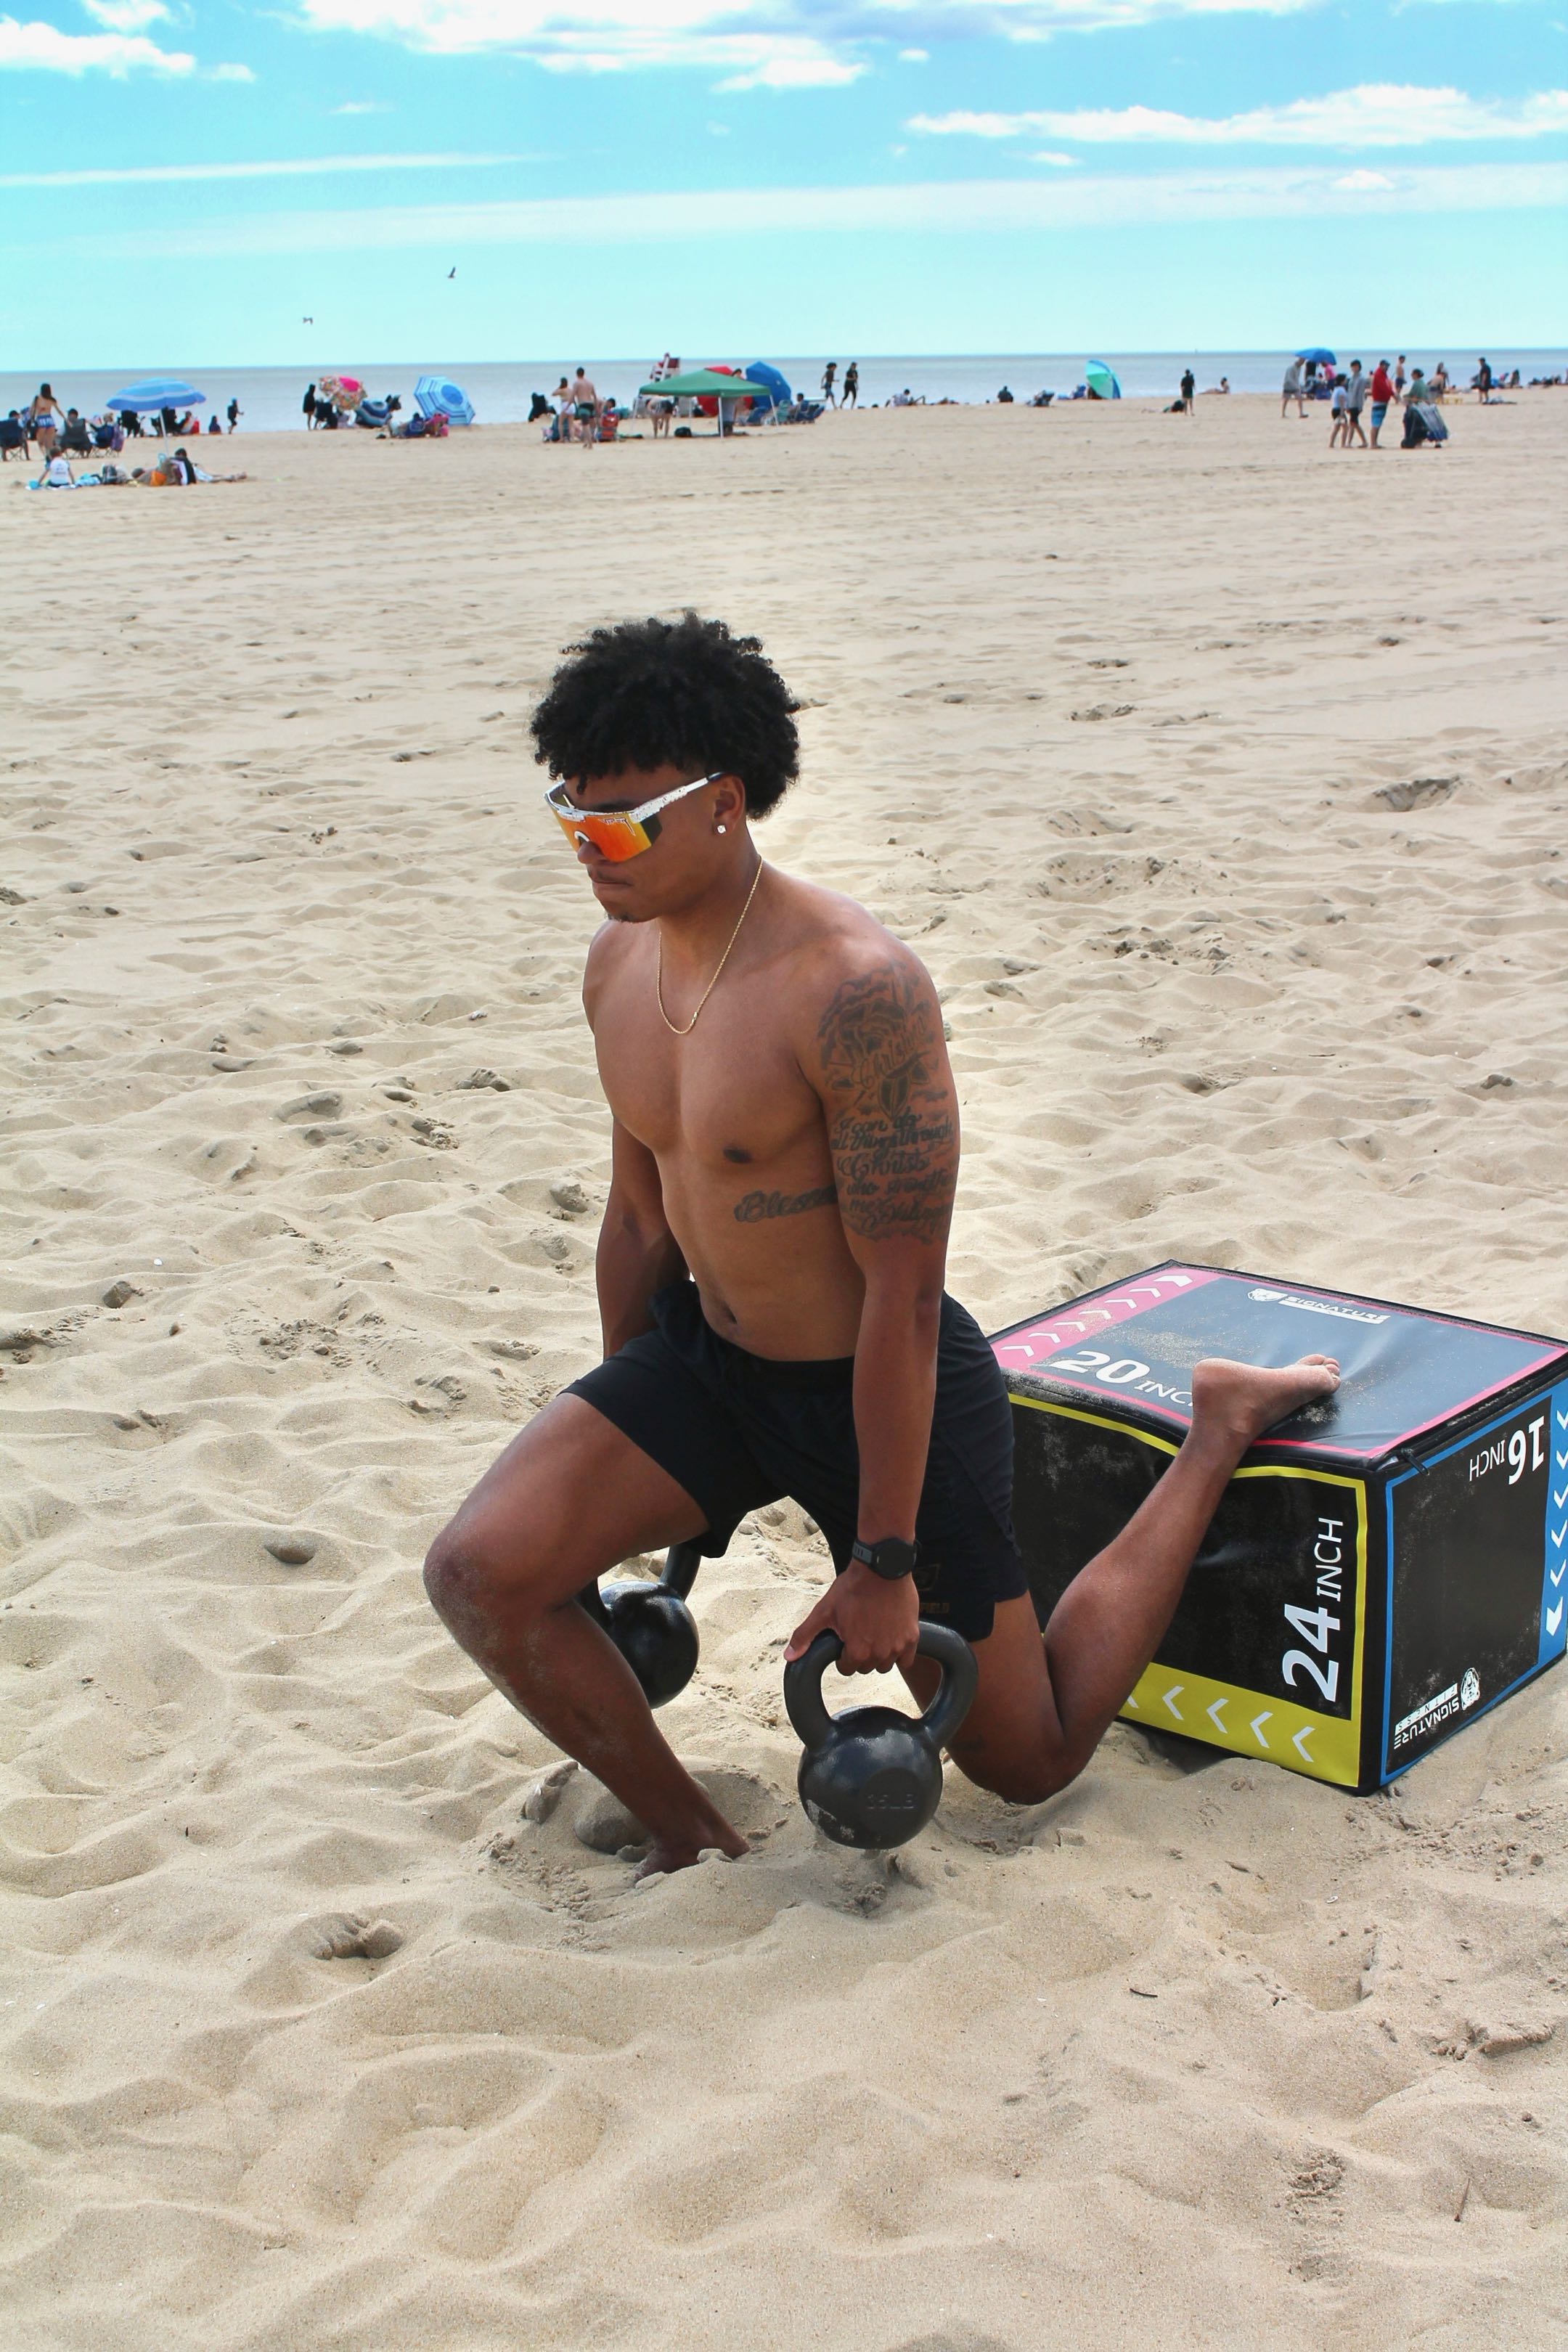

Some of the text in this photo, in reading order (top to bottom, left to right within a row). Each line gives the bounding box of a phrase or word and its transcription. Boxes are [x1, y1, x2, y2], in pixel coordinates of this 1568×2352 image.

[1286, 1296, 1392, 1320] SIGNATURE
[1051, 1350, 1193, 1407] 20 INC
[1469, 1416, 1545, 1485] 16 INCH
[1282, 1517, 1344, 1702] 24 INCH
[1394, 1697, 1460, 1749] SIGNATURE
[1398, 1686, 1455, 1731] FITNESS
